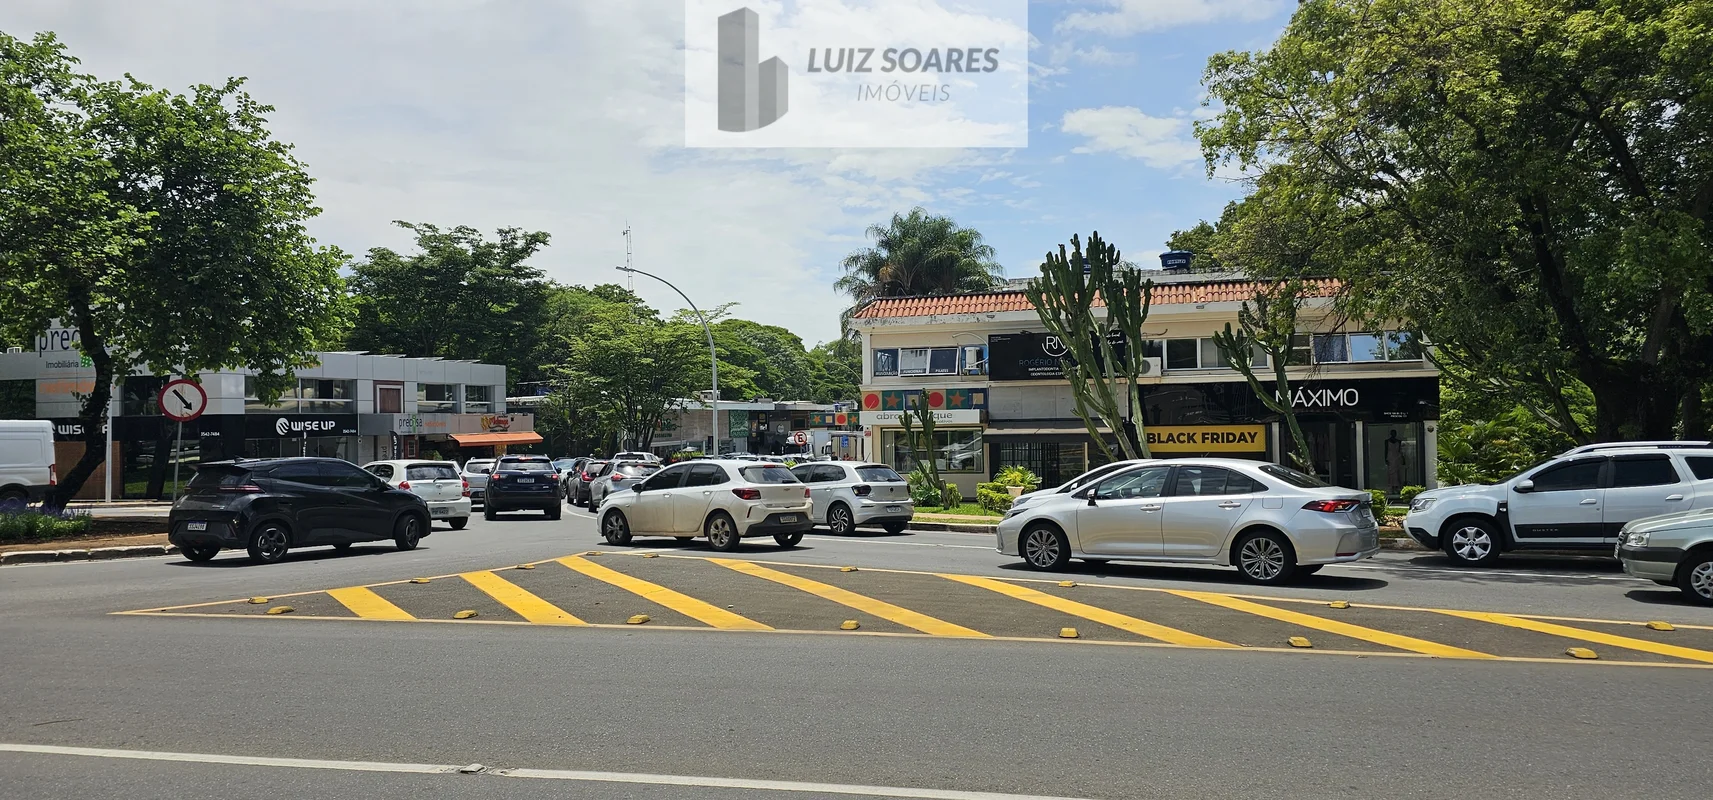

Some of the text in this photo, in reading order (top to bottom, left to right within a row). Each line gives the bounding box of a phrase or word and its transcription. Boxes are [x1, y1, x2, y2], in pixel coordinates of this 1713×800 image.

[45, 360, 79, 369] Imobiliária
[1018, 357, 1053, 367] ROGÉRIO
[1275, 386, 1359, 408] MÁXIMO
[290, 421, 336, 431] WISE UP
[1147, 432, 1258, 444] BLACK FRIDAY
